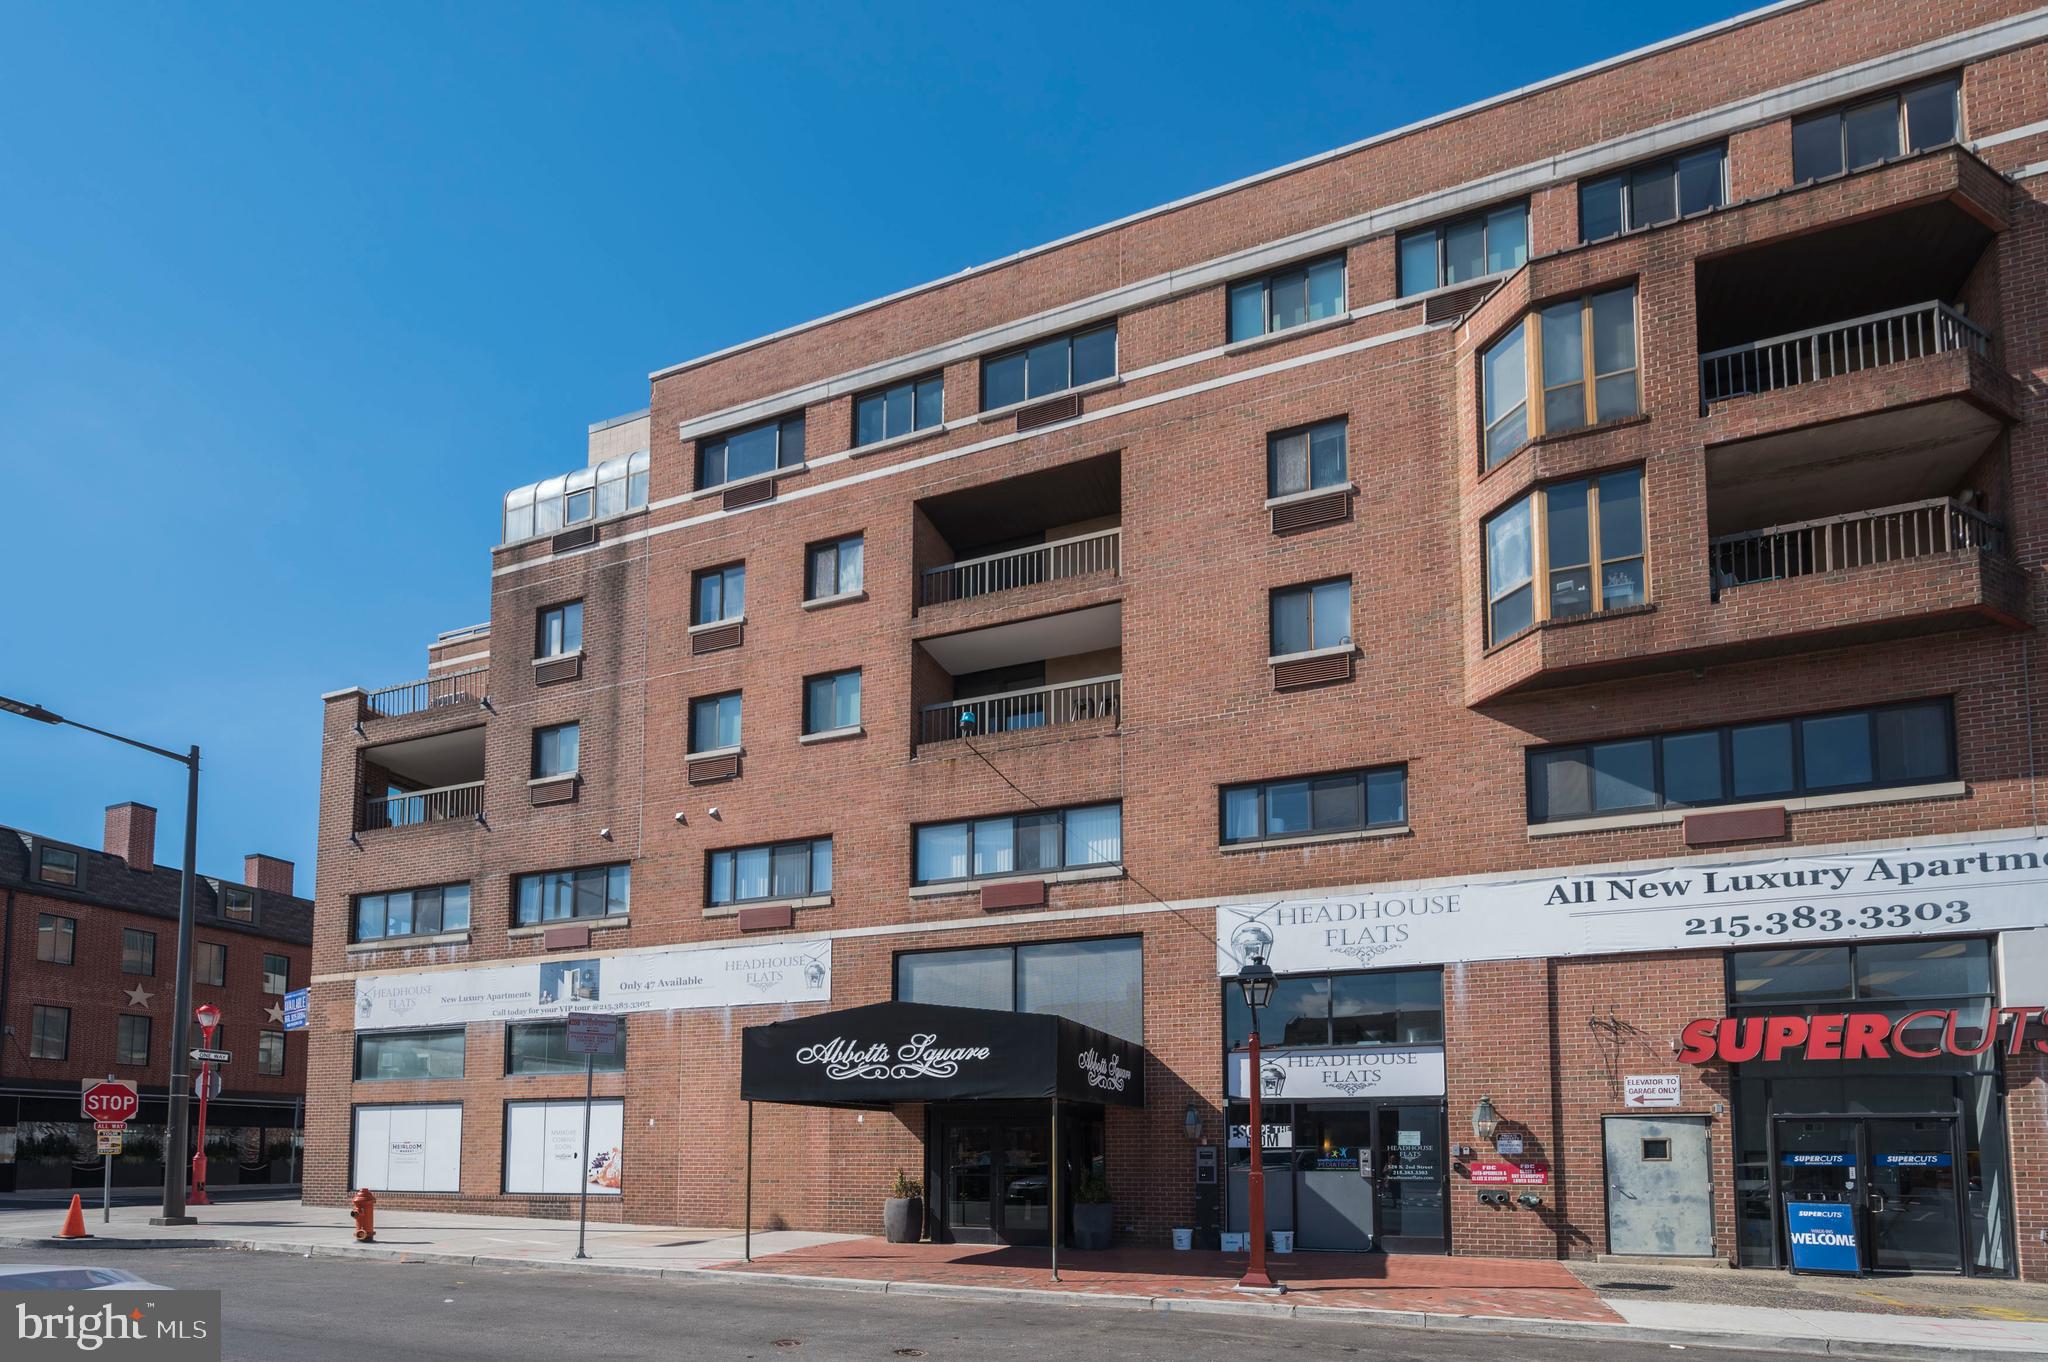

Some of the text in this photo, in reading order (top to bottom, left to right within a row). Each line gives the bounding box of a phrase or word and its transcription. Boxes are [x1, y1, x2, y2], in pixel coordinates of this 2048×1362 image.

[1545, 851, 2048, 906] All New Luxury Apartm
[1276, 894, 1461, 926] HEADHOUSE
[1685, 899, 1971, 938] 215.383.3303
[1324, 923, 1409, 947] FLATS
[724, 955, 806, 972] HEADHOUSE
[619, 976, 703, 990] Only 47 Available
[746, 970, 784, 983] FLATS
[373, 985, 432, 999] HEADHOUSE
[440, 991, 532, 1004] New Luxury Apartments
[388, 999, 417, 1009] FLATS
[492, 1009, 506, 1017] Call
[507, 1008, 527, 1018] today
[540, 1007, 559, 1016] your
[559, 1005, 574, 1013] VIP
[574, 1004, 591, 1012] tour
[796, 1034, 991, 1069] Abbotts Square
[1078, 1048, 1131, 1081] Abbotts Square
[1288, 1052, 1418, 1068] HEADHOUSE
[1322, 1069, 1382, 1083] FLATS
[1628, 1087, 1657, 1095] GARAGE
[87, 1095, 135, 1111] STOP
[1230, 1124, 1291, 1138] ESCPE THE
[1794, 1155, 1843, 1163] SUPERCUTS
[1887, 1155, 1938, 1163] SUPERCUTS
[1799, 1210, 1843, 1218] SUPERCUTS
[1790, 1232, 1857, 1247] WELCOME
